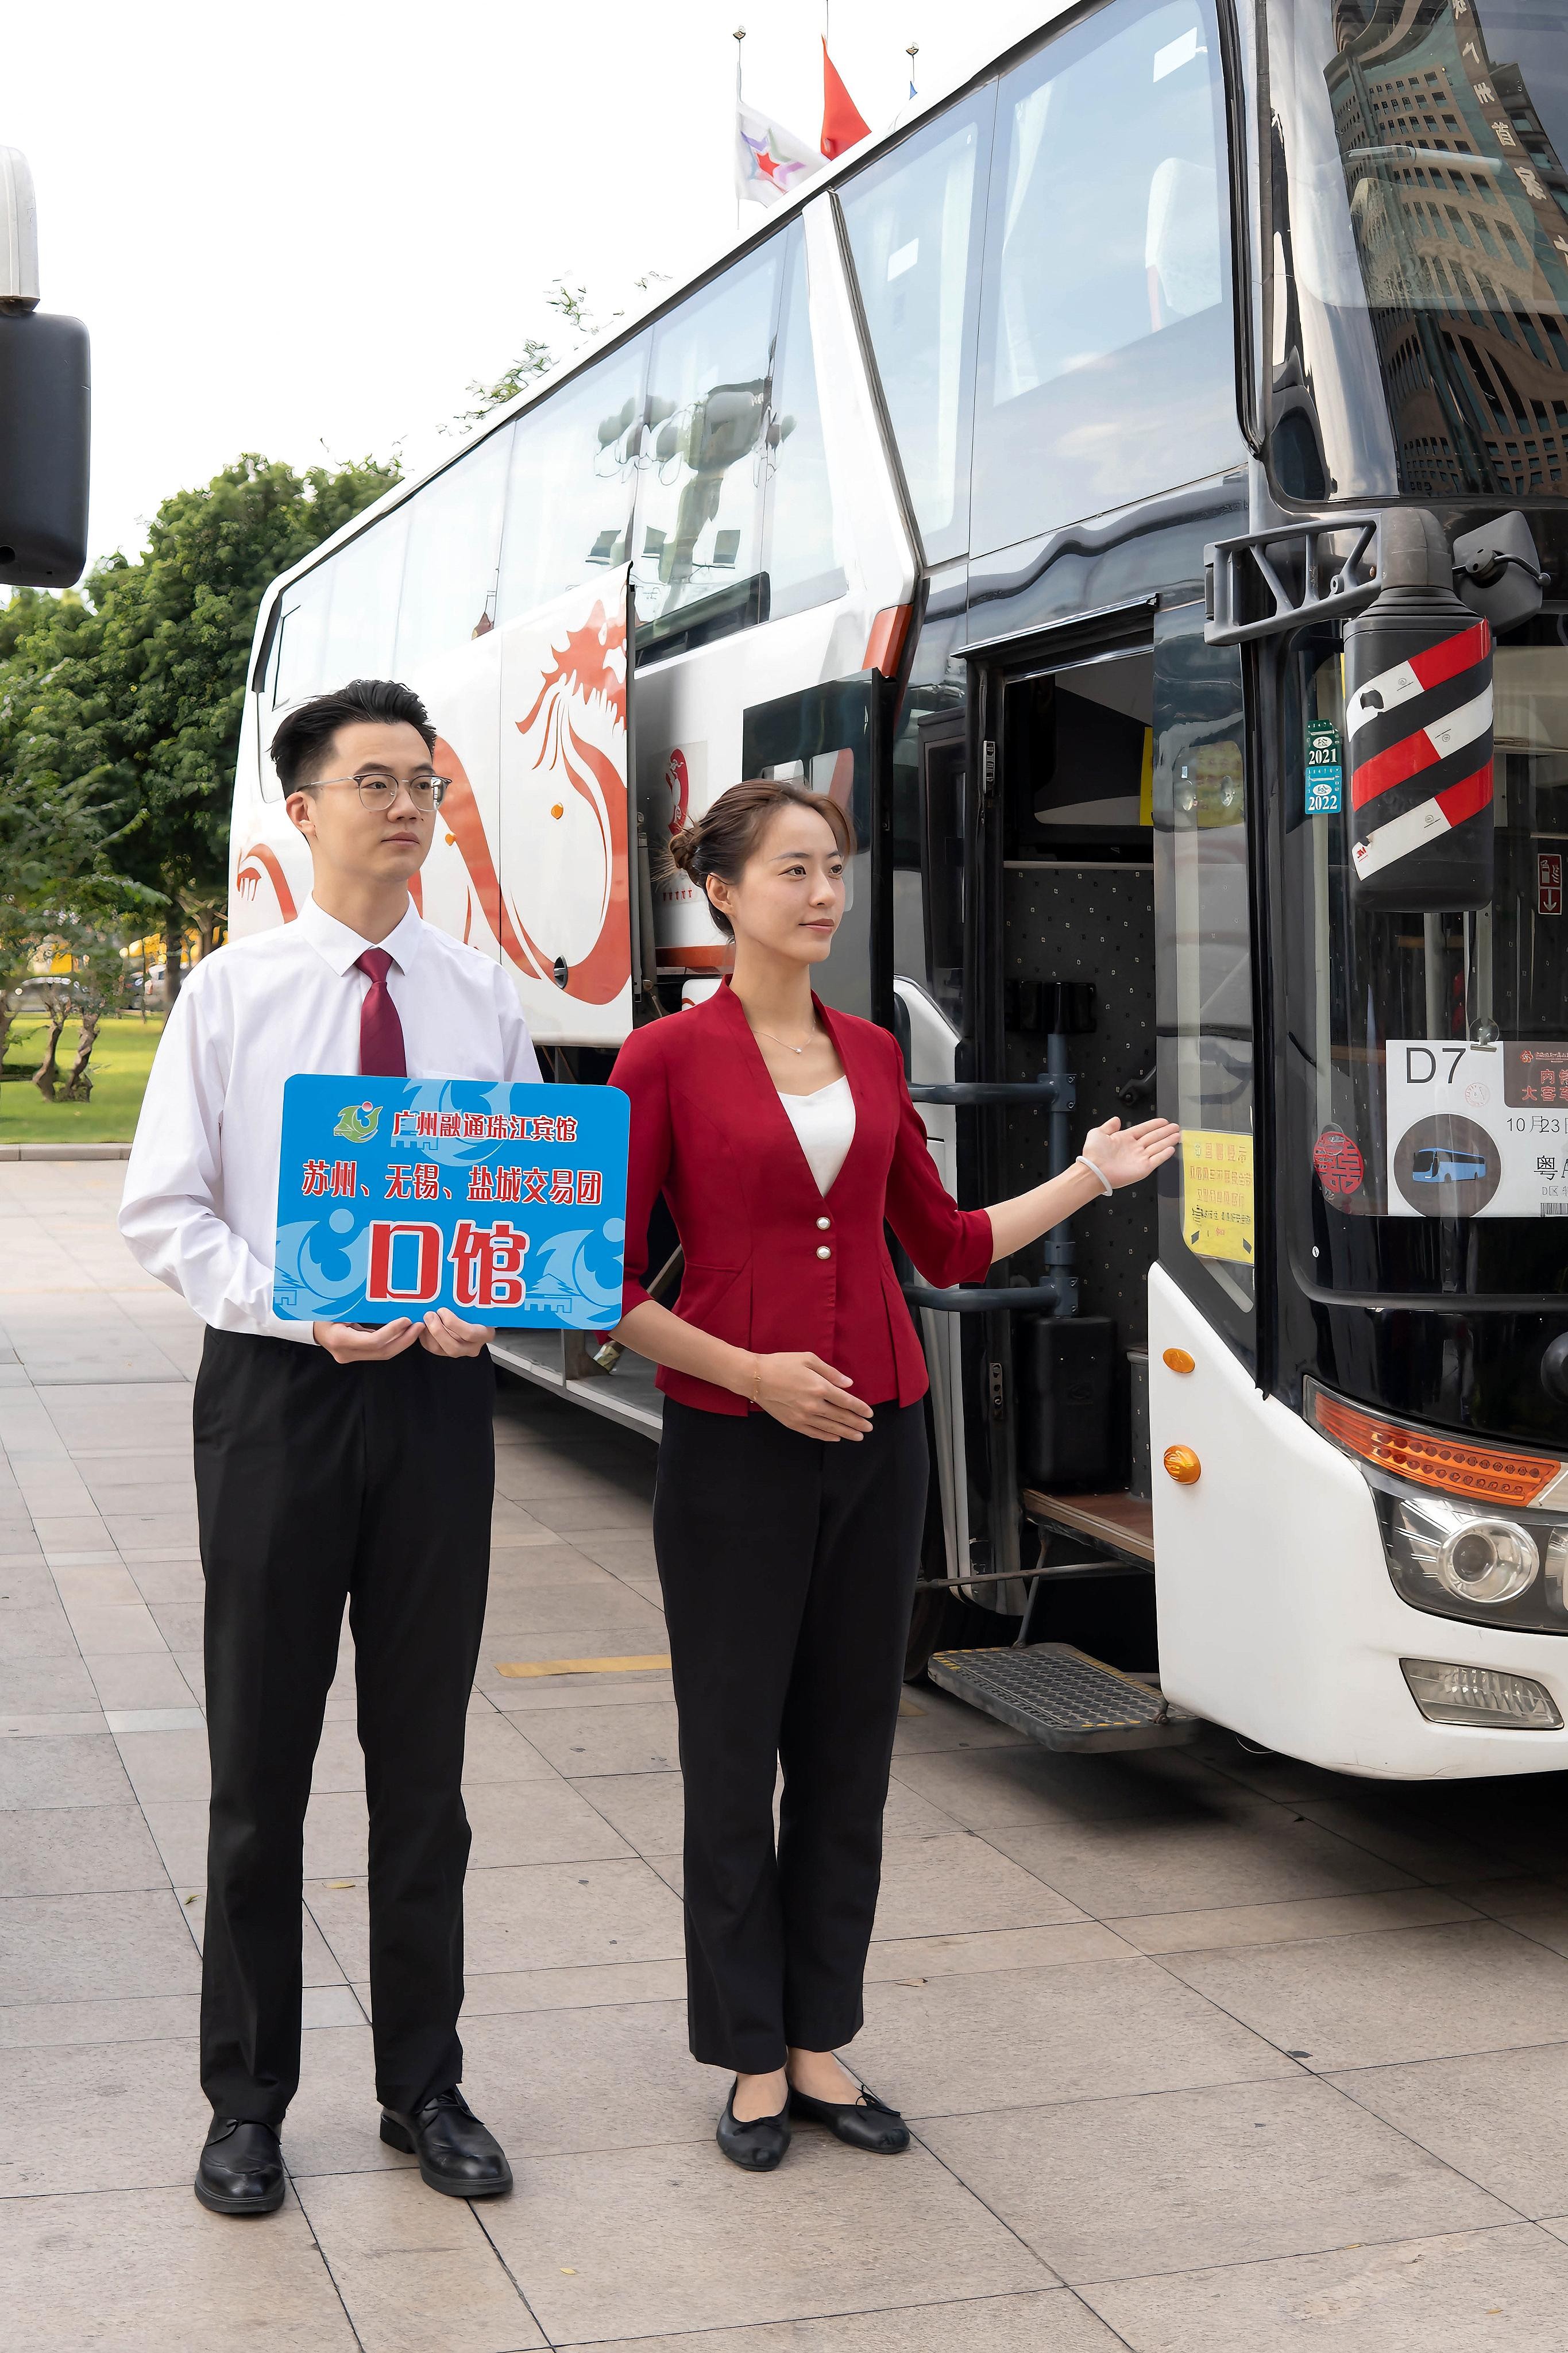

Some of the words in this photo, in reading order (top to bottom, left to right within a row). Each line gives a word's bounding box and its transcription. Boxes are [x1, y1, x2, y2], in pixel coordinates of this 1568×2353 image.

[1309, 749, 1337, 765] 2021
[1308, 796, 1338, 811] 2022
[1407, 1047, 1466, 1083] D7
[392, 1110, 578, 1142] 广州融通珠江宾馆
[302, 1159, 603, 1205] 苏州、无锡、盐城交易团
